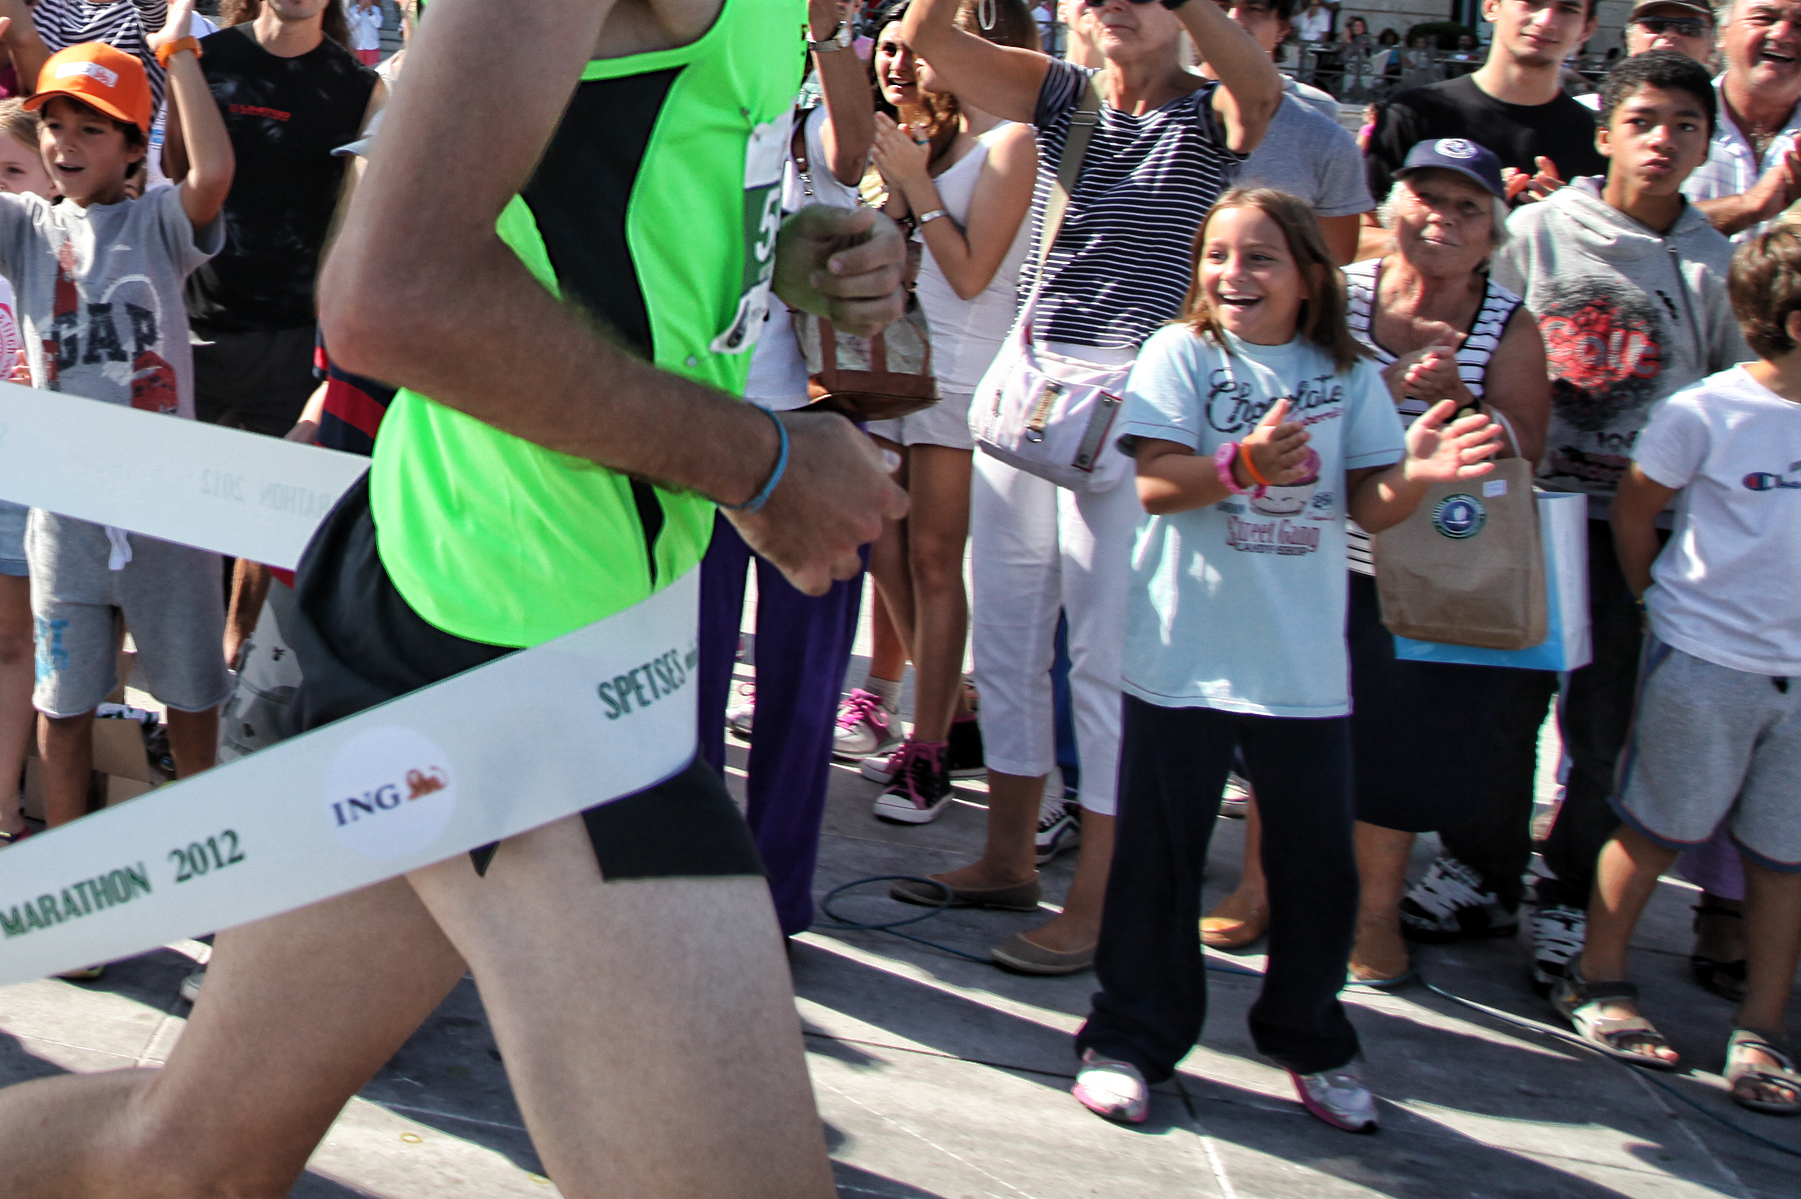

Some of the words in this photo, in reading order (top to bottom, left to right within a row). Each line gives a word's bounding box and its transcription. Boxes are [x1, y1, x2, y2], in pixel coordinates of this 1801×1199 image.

[51, 302, 159, 373] GAP
[597, 649, 687, 720] SPETSES
[167, 829, 247, 885] 2012
[330, 782, 402, 828] ING
